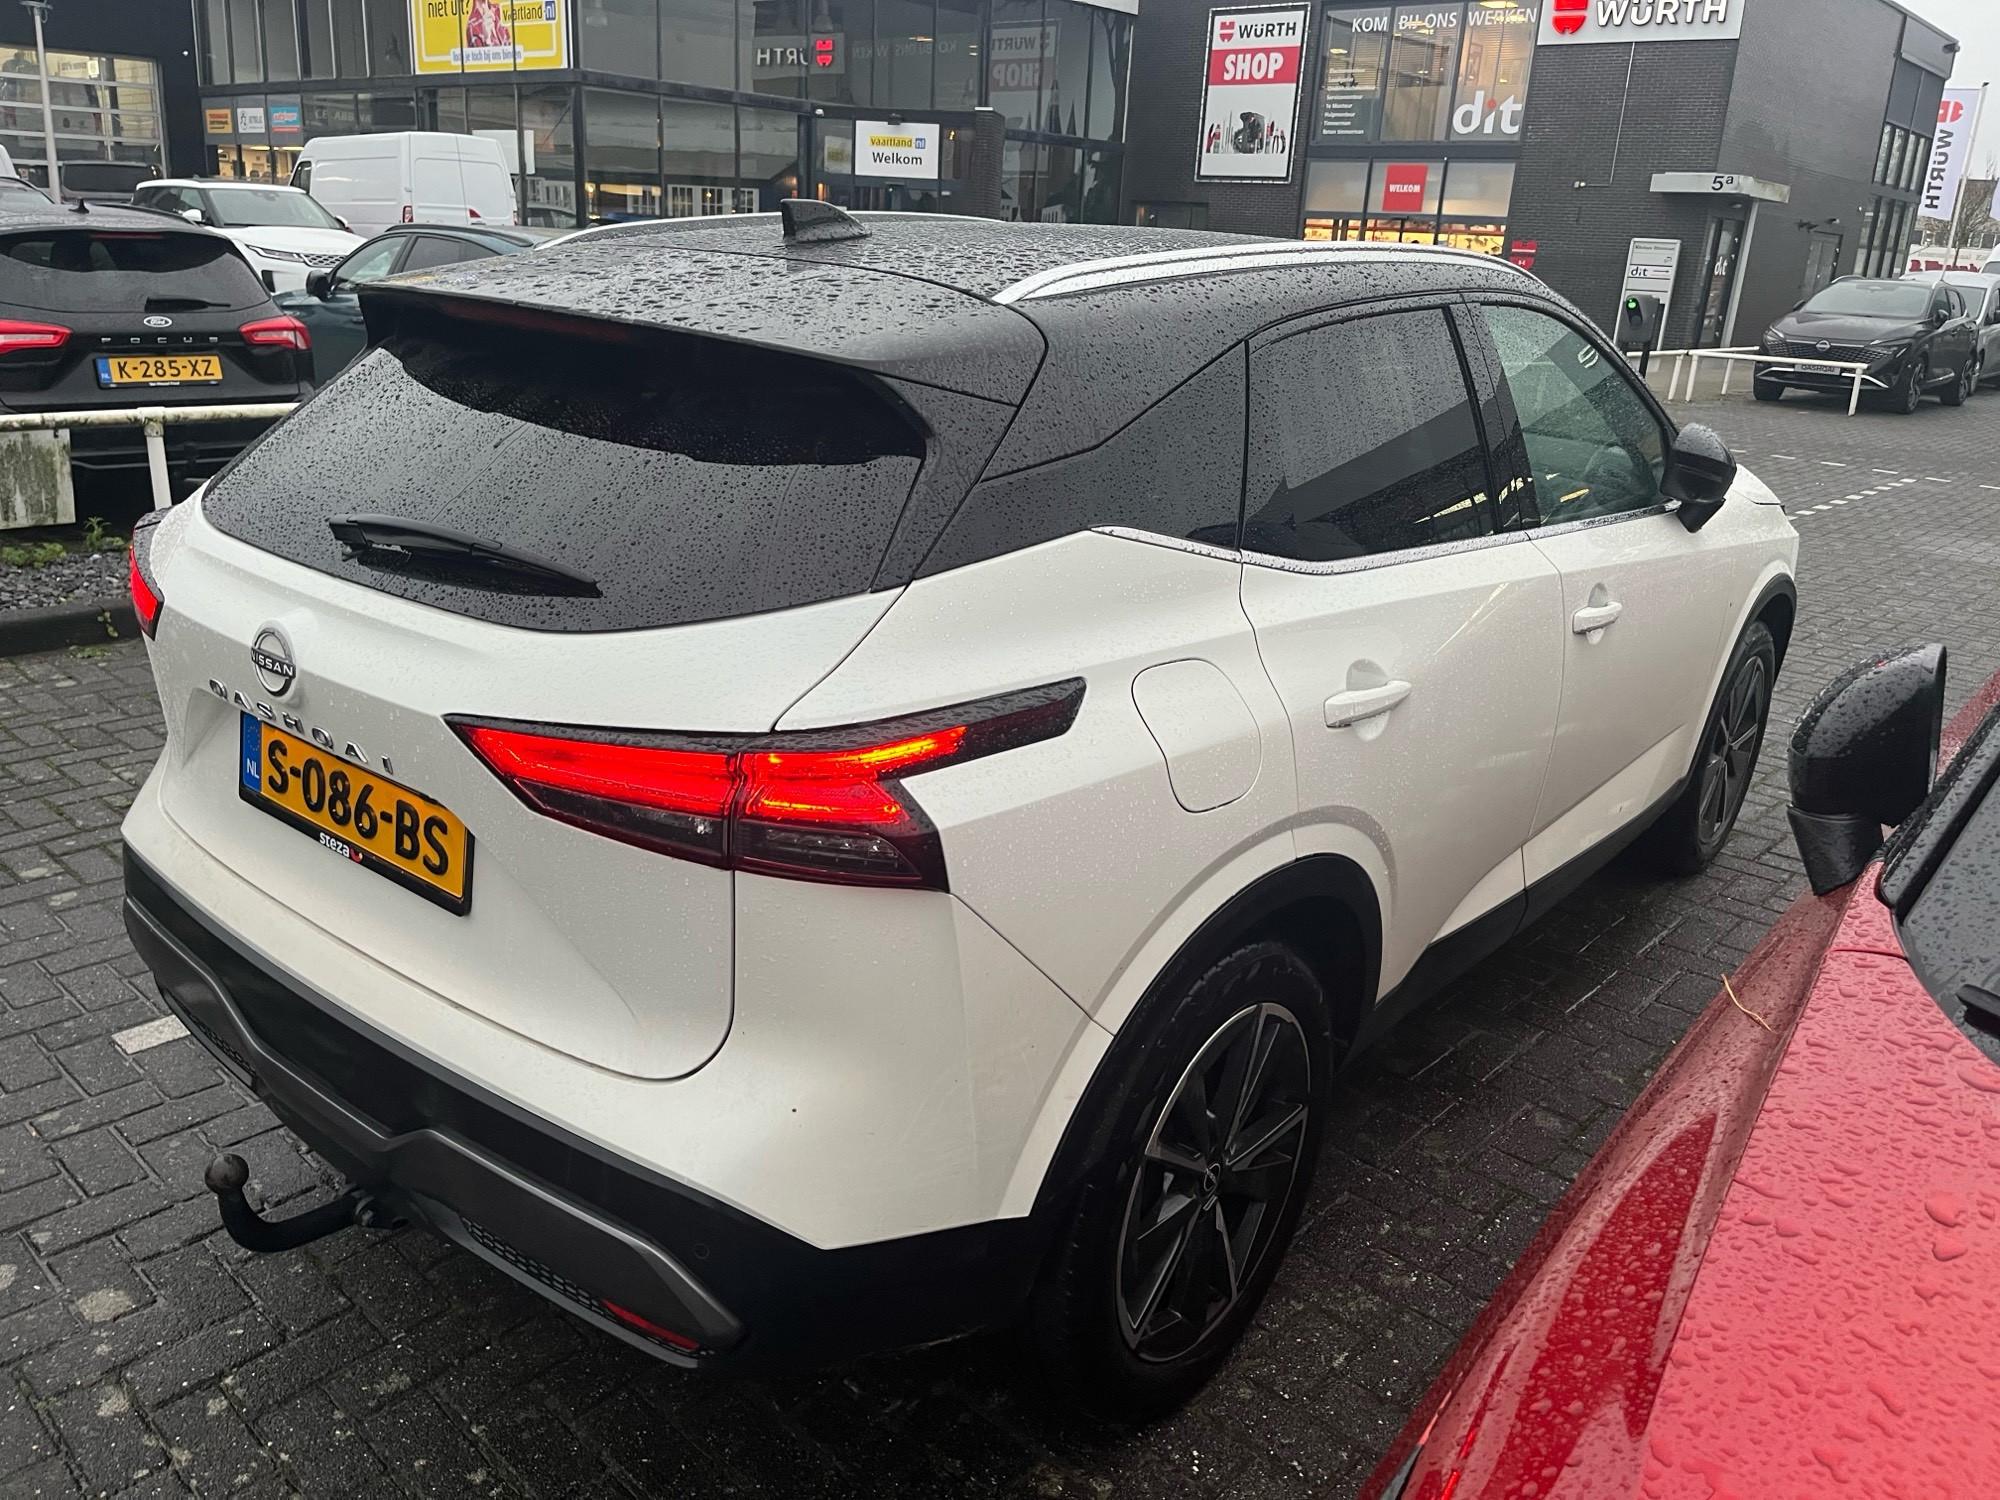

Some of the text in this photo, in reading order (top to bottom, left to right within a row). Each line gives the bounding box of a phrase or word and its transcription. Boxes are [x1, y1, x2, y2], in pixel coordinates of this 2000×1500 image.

[428, 0, 470, 18] niet ut?
[1352, 17, 1388, 32] KOM
[1424, 13, 1457, 28] ONS
[1468, 8, 1537, 26] WERKEN
[1596, 0, 1728, 26] WÜRTH
[1239, 22, 1297, 38] WÜRTH
[1224, 53, 1284, 80] SHOP
[1453, 90, 1522, 134] dit
[872, 152, 922, 165] Welkom
[1389, 184, 1421, 193] WELKOM
[1630, 266, 1648, 277] dit
[1714, 256, 1727, 276] dit
[117, 359, 215, 379] K-285-XZ
[251, 649, 293, 676] NISSAN
[208, 678, 394, 775] QASHQAI
[245, 738, 450, 877] NL S-086-BS
[319, 831, 350, 859] steza
